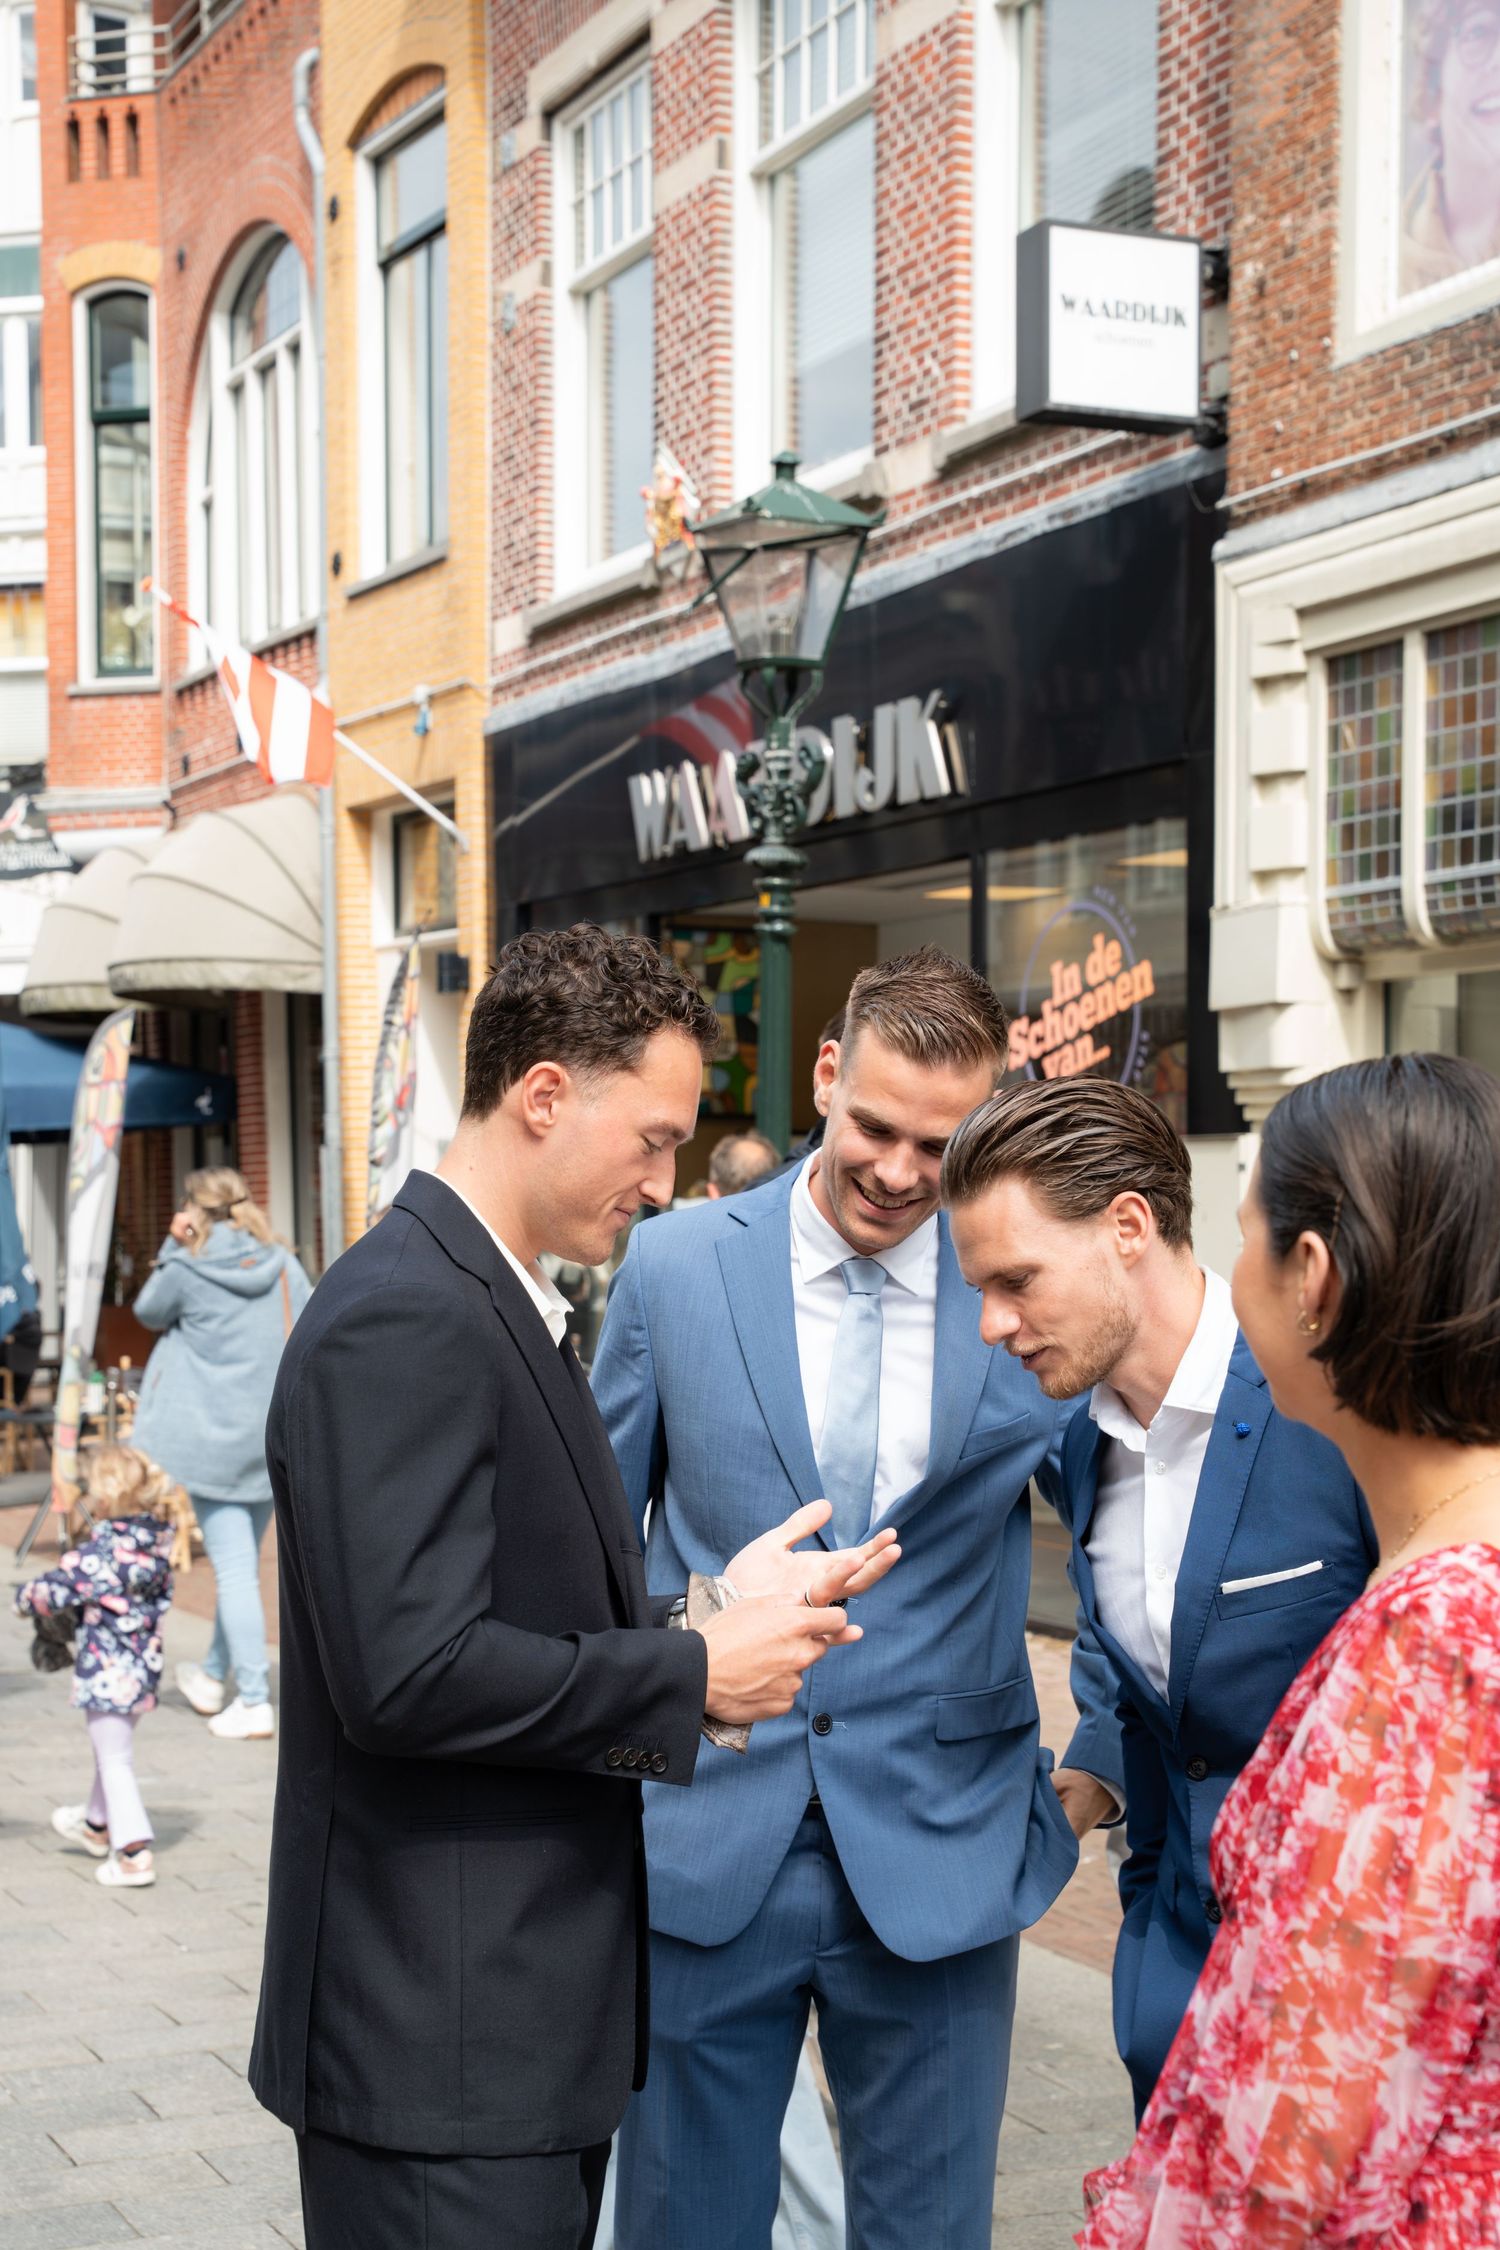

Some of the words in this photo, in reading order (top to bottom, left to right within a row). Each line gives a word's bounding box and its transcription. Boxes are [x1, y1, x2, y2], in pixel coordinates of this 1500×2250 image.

[1060, 293, 1187, 328] WAARDIJK
[628, 688, 952, 863] WAADIJK
[1007, 959, 1156, 1071] Schoenen
[1050, 959, 1083, 1007] In
[1085, 932, 1122, 986] de
